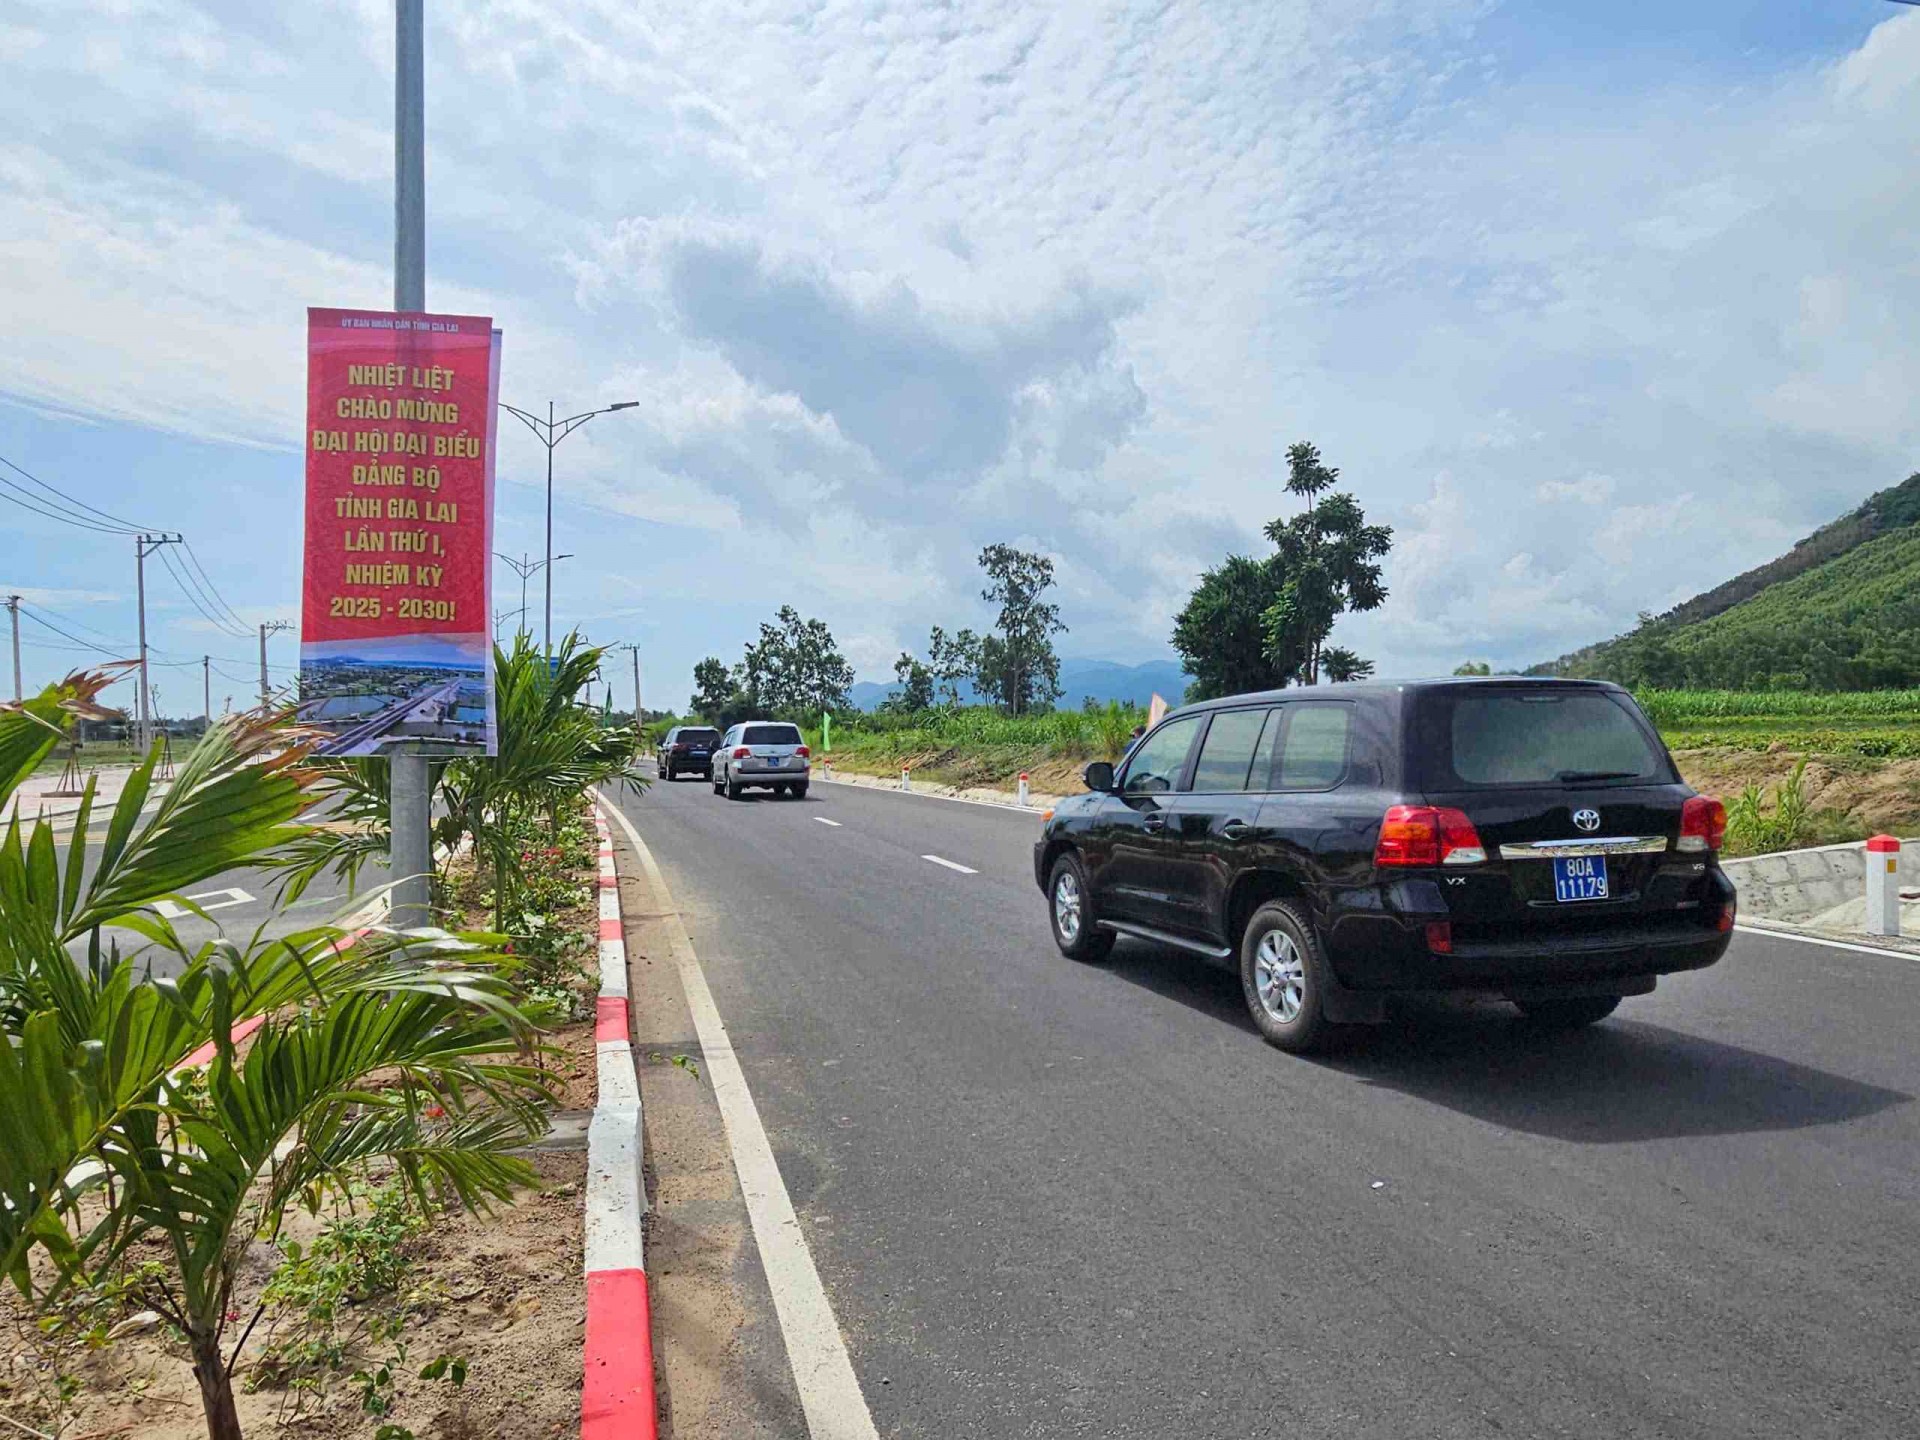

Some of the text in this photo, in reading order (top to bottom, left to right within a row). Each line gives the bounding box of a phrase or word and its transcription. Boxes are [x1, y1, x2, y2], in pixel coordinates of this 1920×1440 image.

[348, 363, 454, 393] NHIỆT LIỆT
[337, 395, 458, 423] CHÀO MỪNG
[313, 429, 480, 458] ĐẠI HỘI ĐẠI BIỂU
[353, 460, 440, 493] ĐẢNG BỘ
[335, 492, 457, 523] TỈNH GIA LAI
[345, 525, 445, 557] LẦN THỨ I,
[346, 561, 443, 589] NHIỆM KỲ
[330, 597, 381, 617] 2025
[398, 600, 455, 621] 2030!
[1446, 876, 1467, 886] VX
[1567, 857, 1594, 877] 80A
[1559, 876, 1606, 899] 111.79
